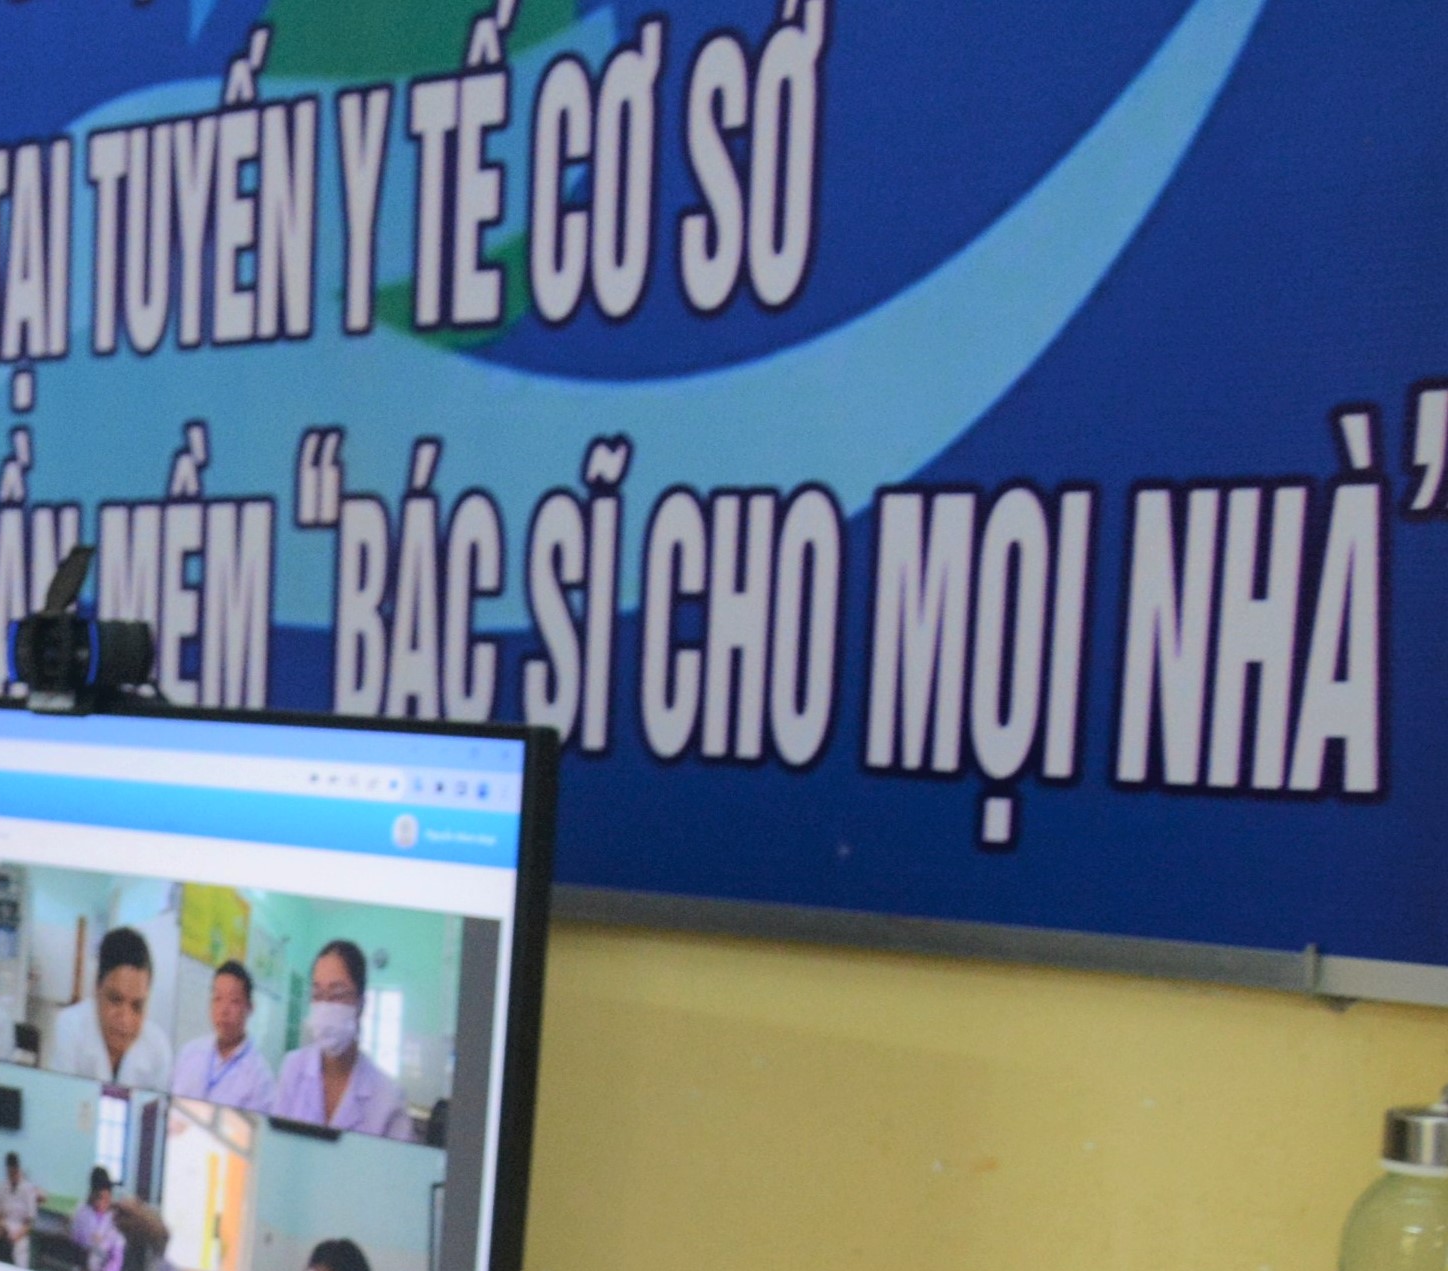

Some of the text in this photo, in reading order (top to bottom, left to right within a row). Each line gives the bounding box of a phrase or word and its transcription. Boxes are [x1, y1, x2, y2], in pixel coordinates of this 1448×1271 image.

[88, 27, 316, 355] TUYẾN
[338, 88, 390, 331] Y
[410, 0, 516, 327] TẾ
[532, 20, 662, 321] CƠ
[523, 440, 630, 752] SĨ
[640, 488, 842, 766] CHO
[864, 487, 1092, 843] MỌI
